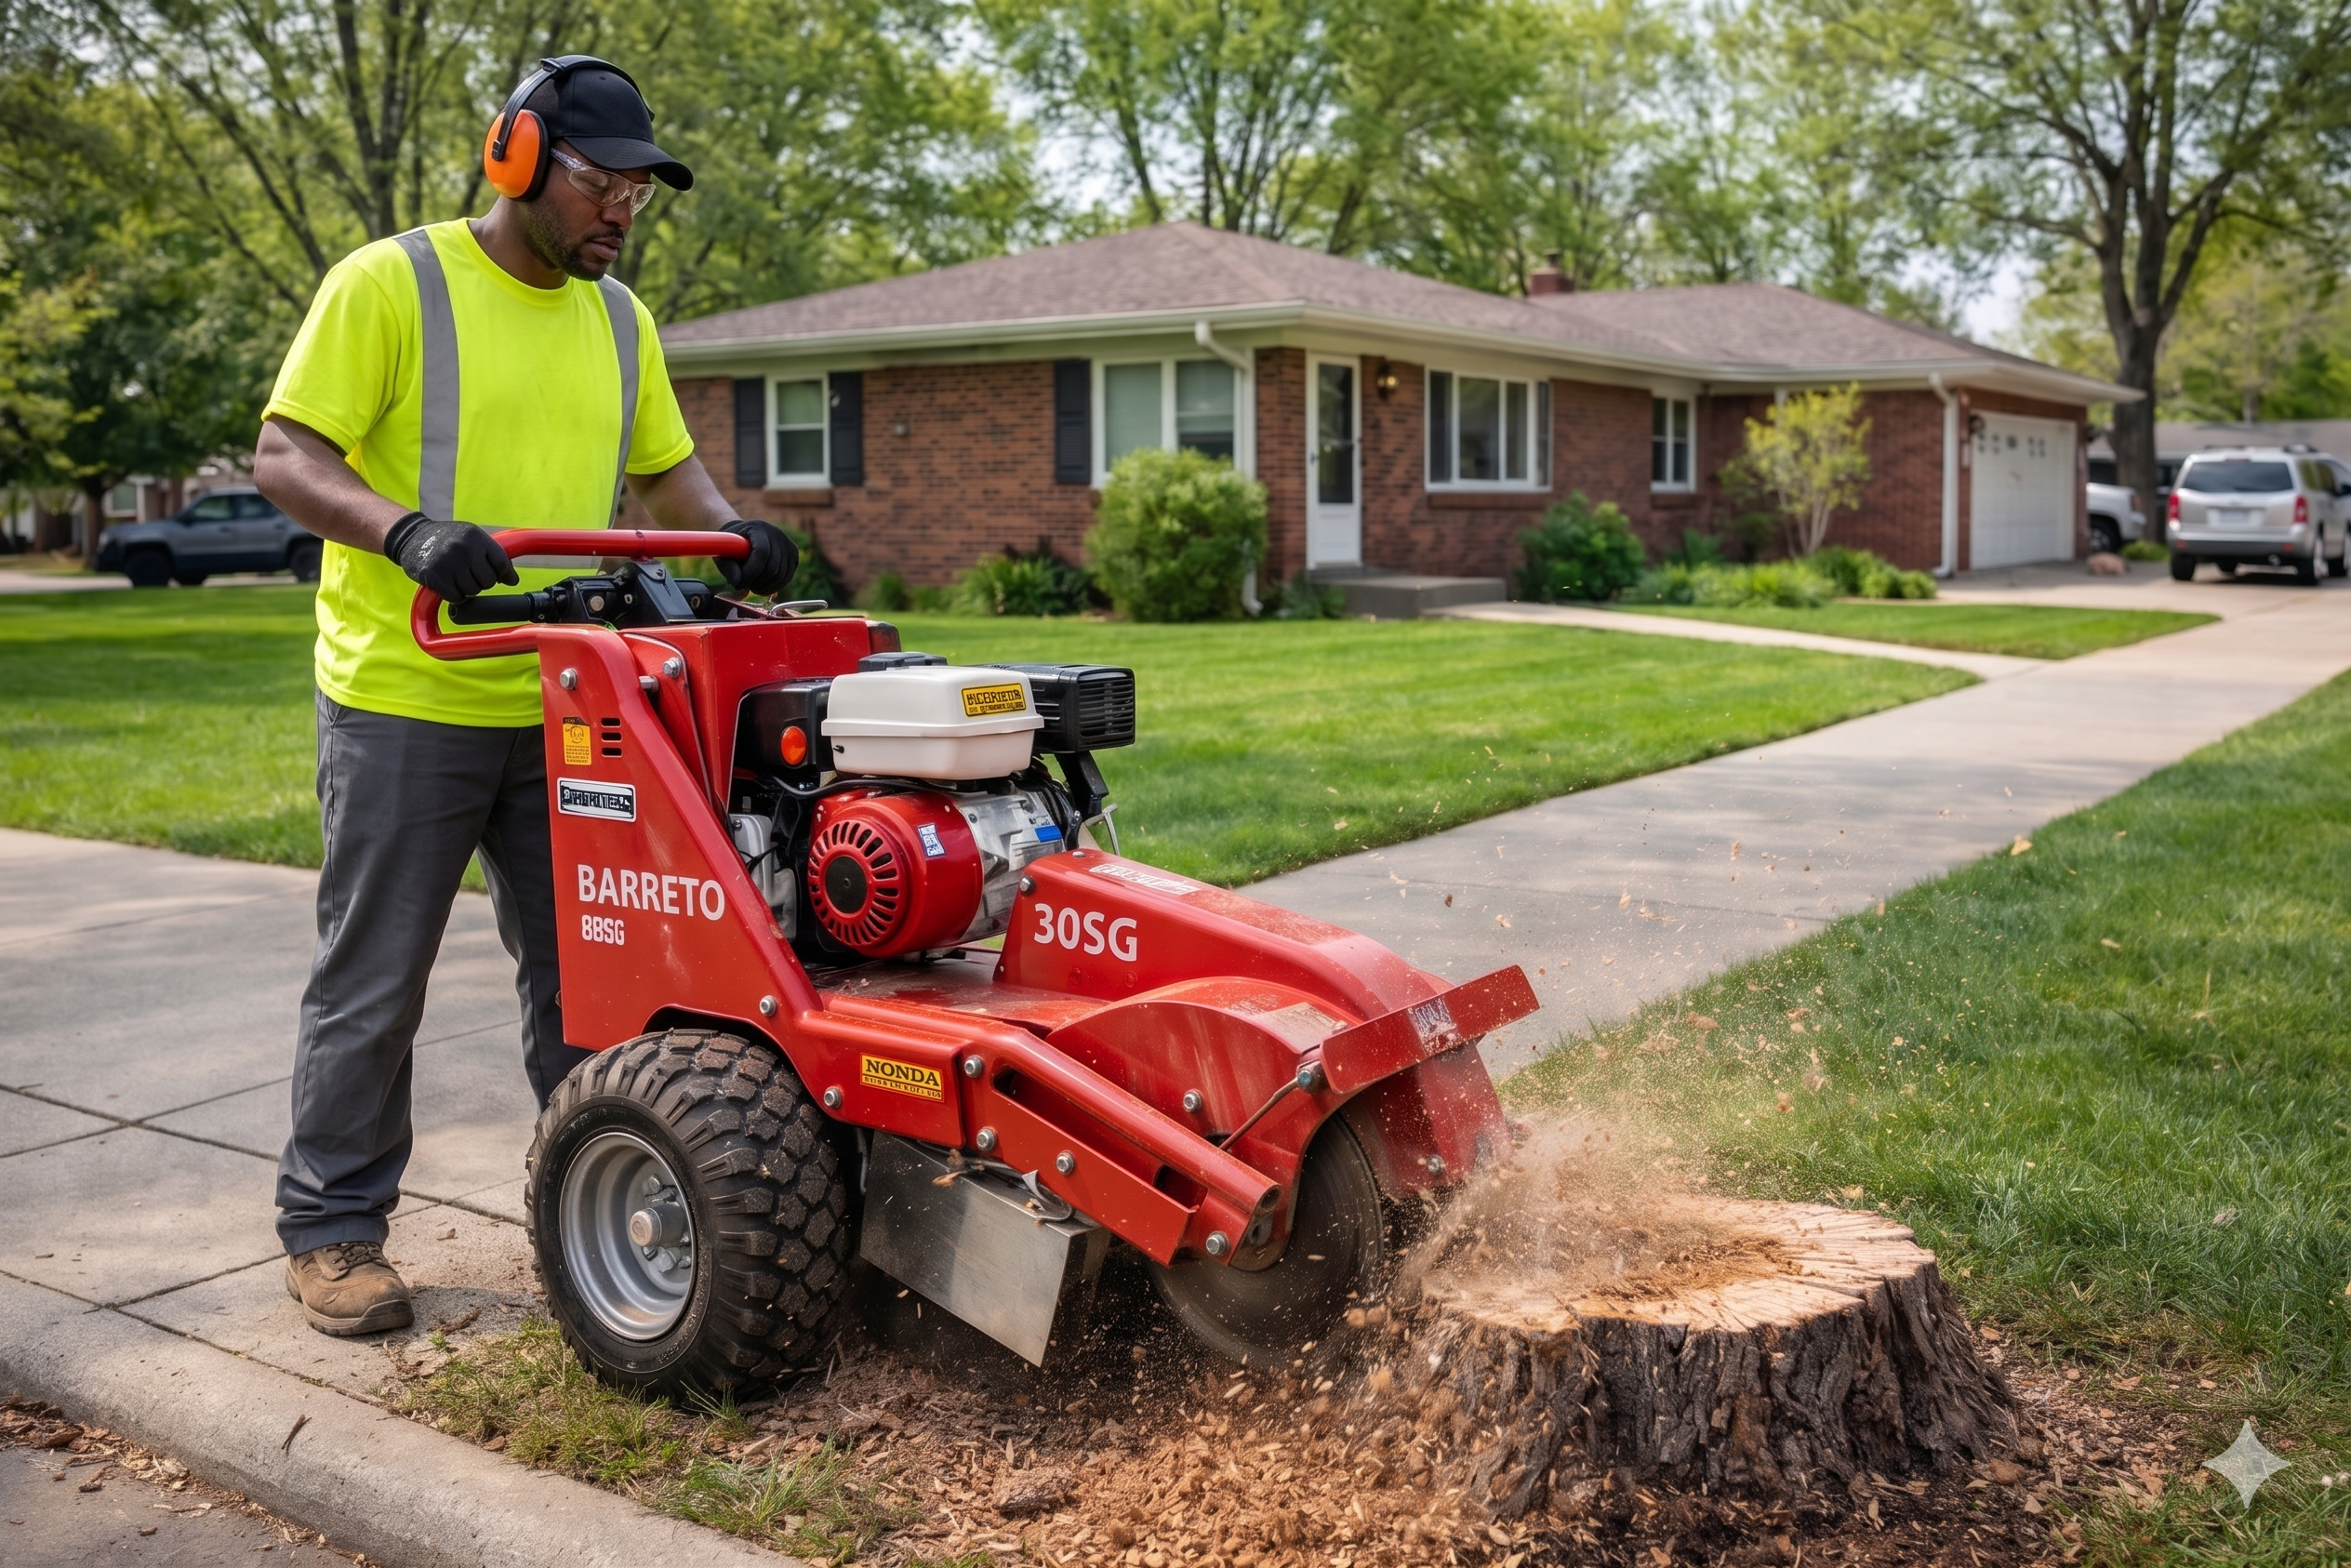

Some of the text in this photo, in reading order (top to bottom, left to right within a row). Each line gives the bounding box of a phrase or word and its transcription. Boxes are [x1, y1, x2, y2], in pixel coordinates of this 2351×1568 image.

[578, 864, 725, 921] BARRETO
[1033, 903, 1137, 962] 30SG
[865, 1058, 940, 1087] NONDA
